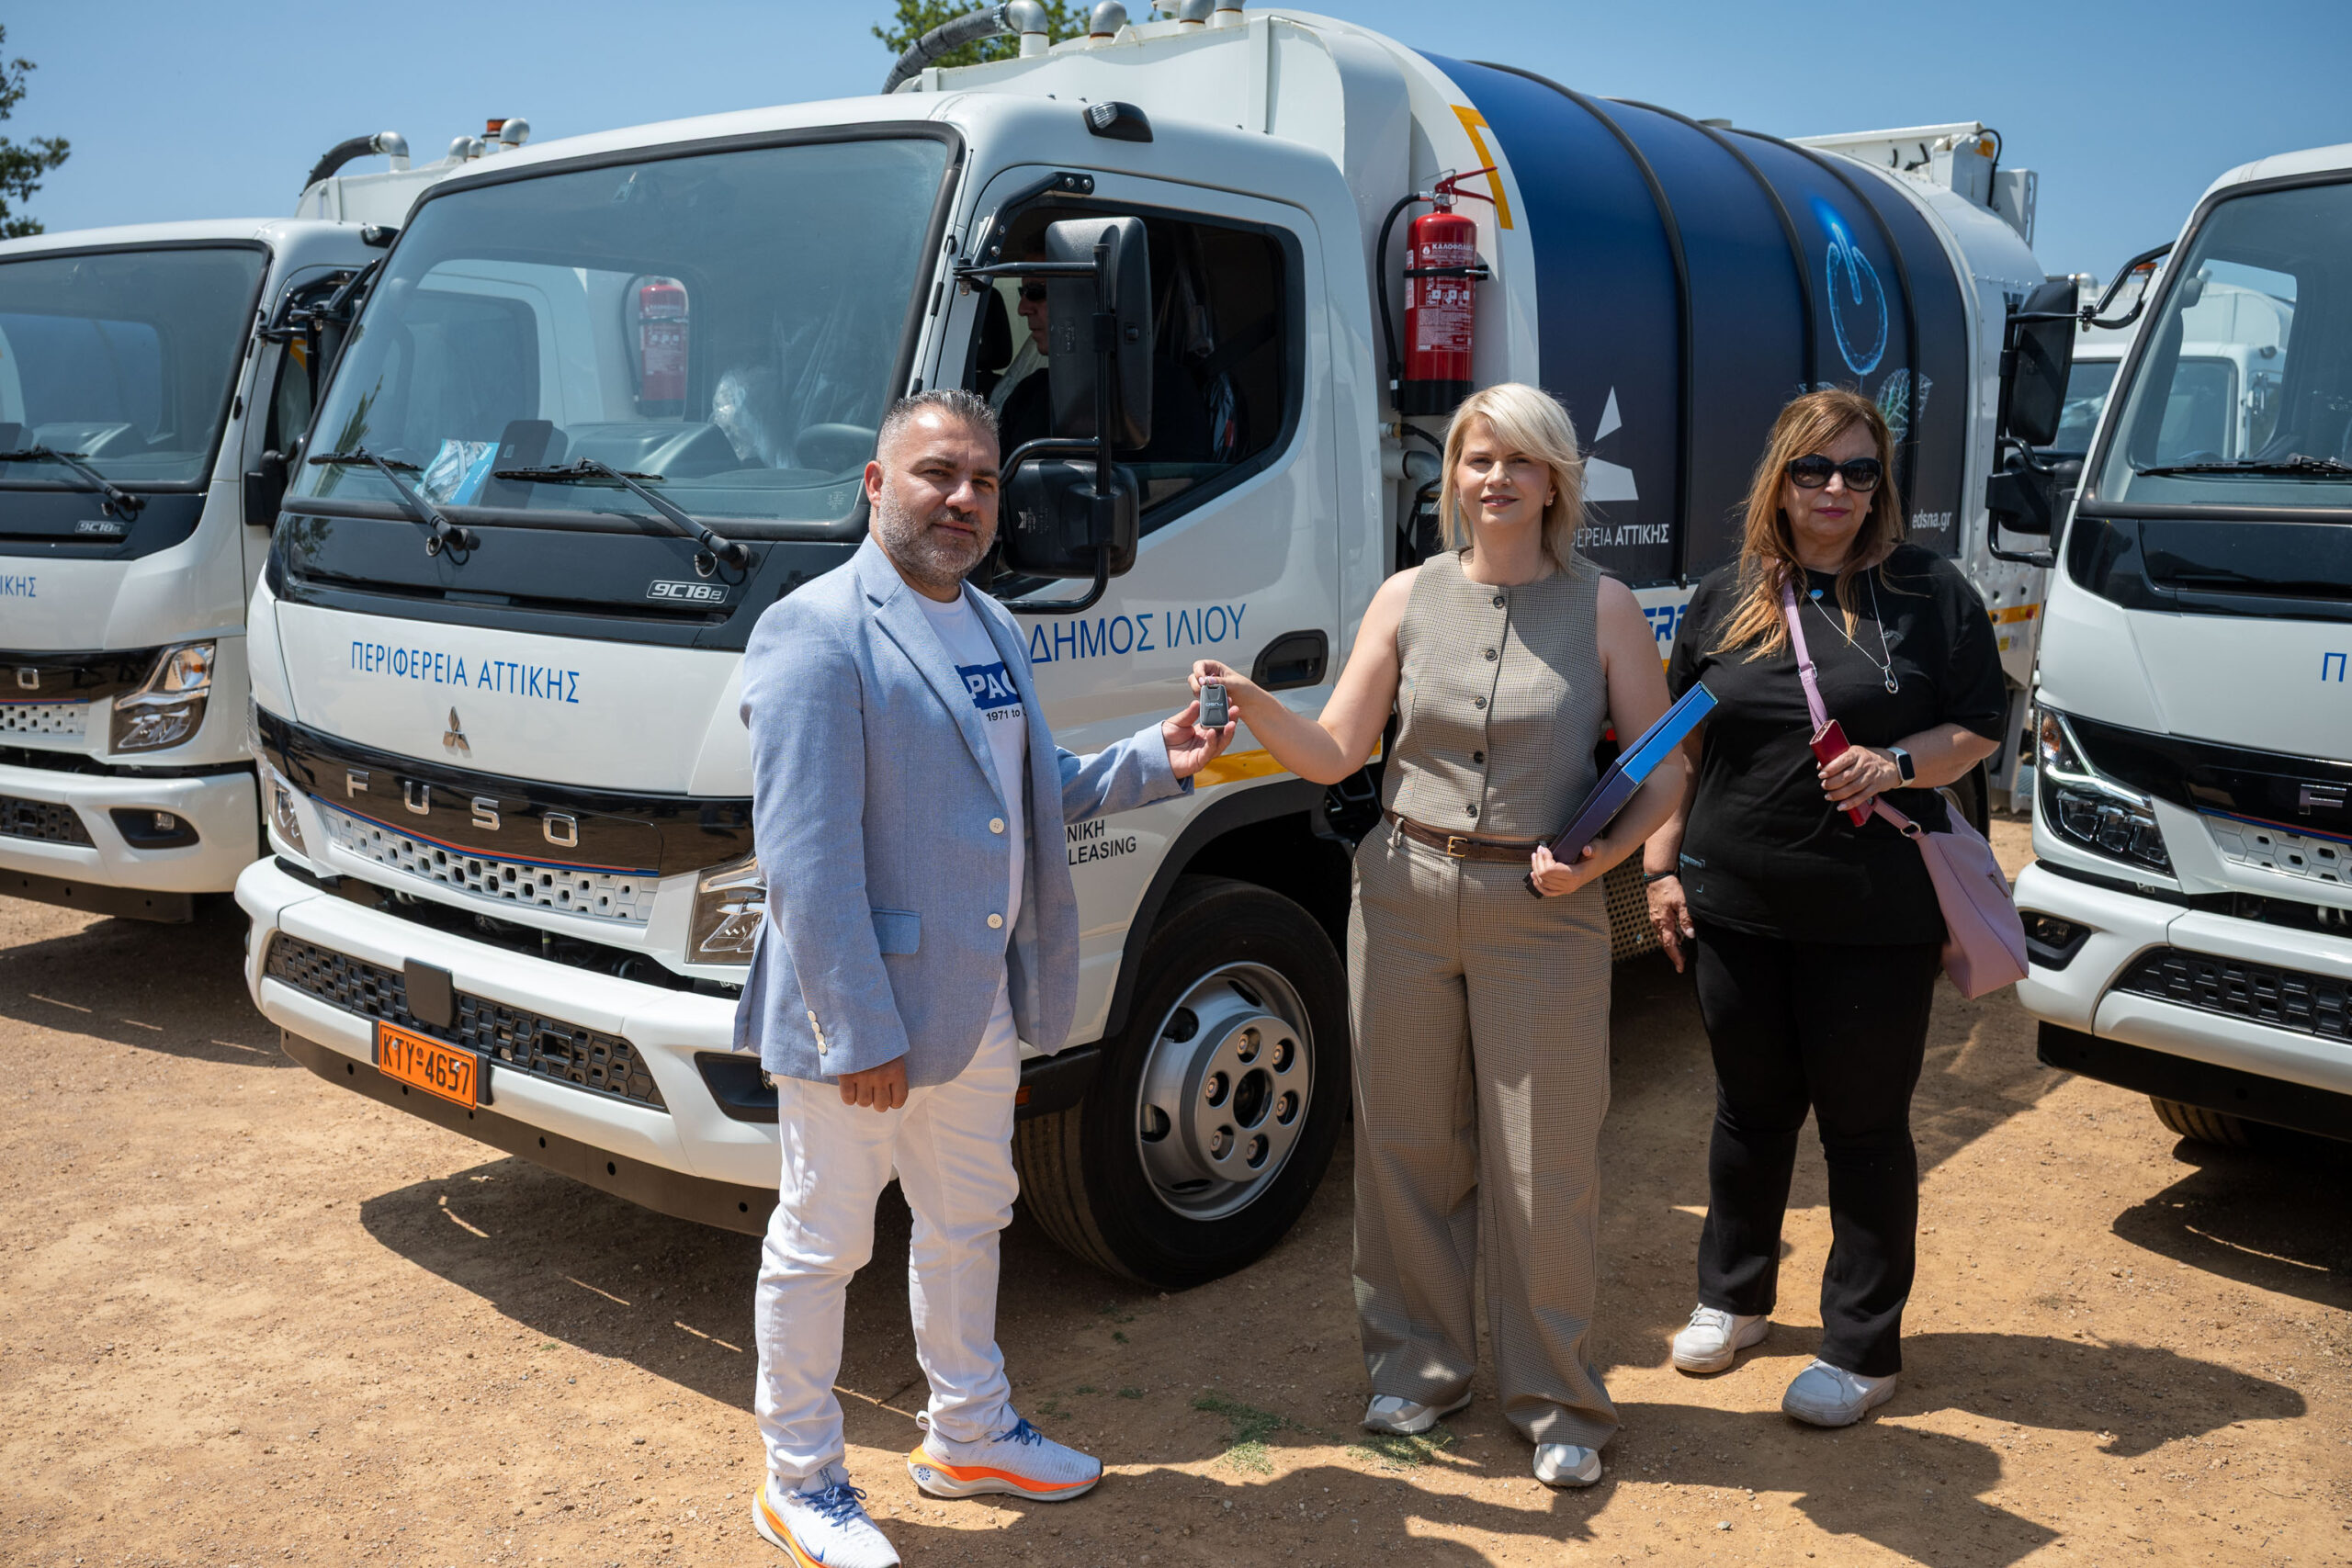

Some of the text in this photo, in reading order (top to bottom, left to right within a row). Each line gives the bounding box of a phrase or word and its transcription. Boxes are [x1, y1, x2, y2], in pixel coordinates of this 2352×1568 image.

[1912, 508, 1952, 532] edsna.gr
[1614, 524, 1669, 546] ΑΤΤΙΚΗΣ
[1030, 604, 1247, 663] ΔΗΜΟΣ ΙΛΙΟΥ
[351, 641, 580, 704] ΠΕΡΙΦΕΡΕΙΑ ΑΤΤΙΚΗΣ
[986, 709, 1009, 722] 1971
[1012, 708, 1021, 718] to
[345, 768, 579, 849] FUSO
[1065, 818, 1105, 843] ΝΙΚΗ
[1069, 836, 1136, 866] LEASING
